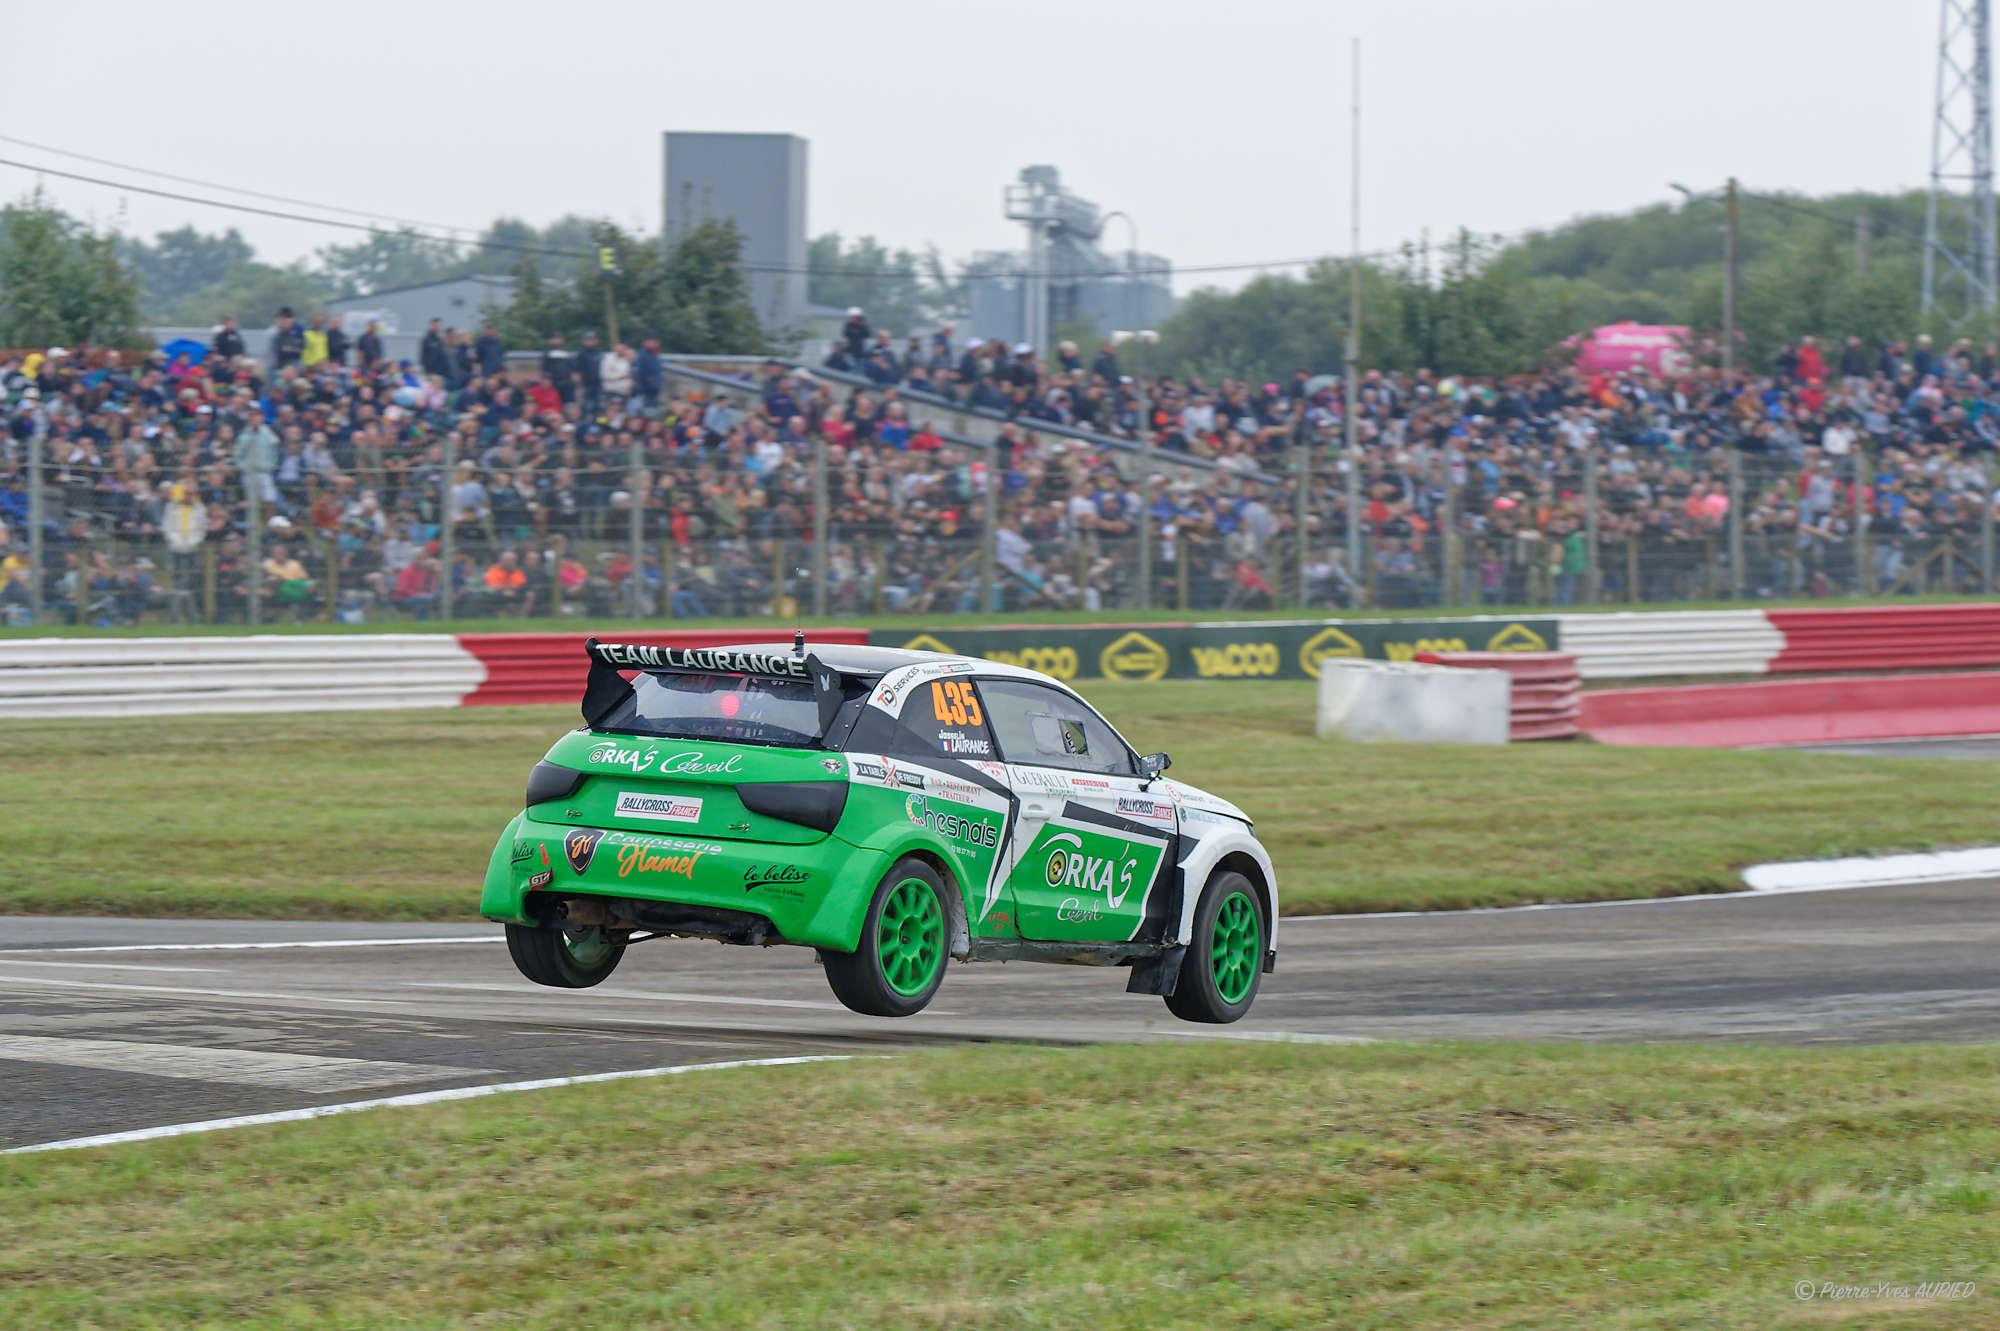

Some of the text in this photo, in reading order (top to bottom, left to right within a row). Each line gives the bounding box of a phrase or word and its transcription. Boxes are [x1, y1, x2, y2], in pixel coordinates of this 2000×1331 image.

[596, 644, 807, 677] TEAM LAURANCE
[894, 667, 920, 692] SERVICES
[931, 681, 982, 726] 435
[951, 739, 989, 754] LAURANCE
[660, 752, 742, 774] Conseil
[868, 766, 885, 778] TABLE
[942, 790, 970, 803] TRAITEUR
[946, 780, 982, 796] RESTAURANT
[621, 797, 672, 812] RALLYCROSS
[673, 805, 699, 817] FRANCE
[1119, 797, 1154, 814] RALLYCROSS
[1155, 807, 1172, 819] FRANCE
[906, 793, 997, 848] Chesnais
[608, 832, 722, 855] Carrosserie
[617, 844, 703, 879] Hamel
[744, 864, 809, 880] le belise
[1038, 832, 1137, 909] ORKA'S
